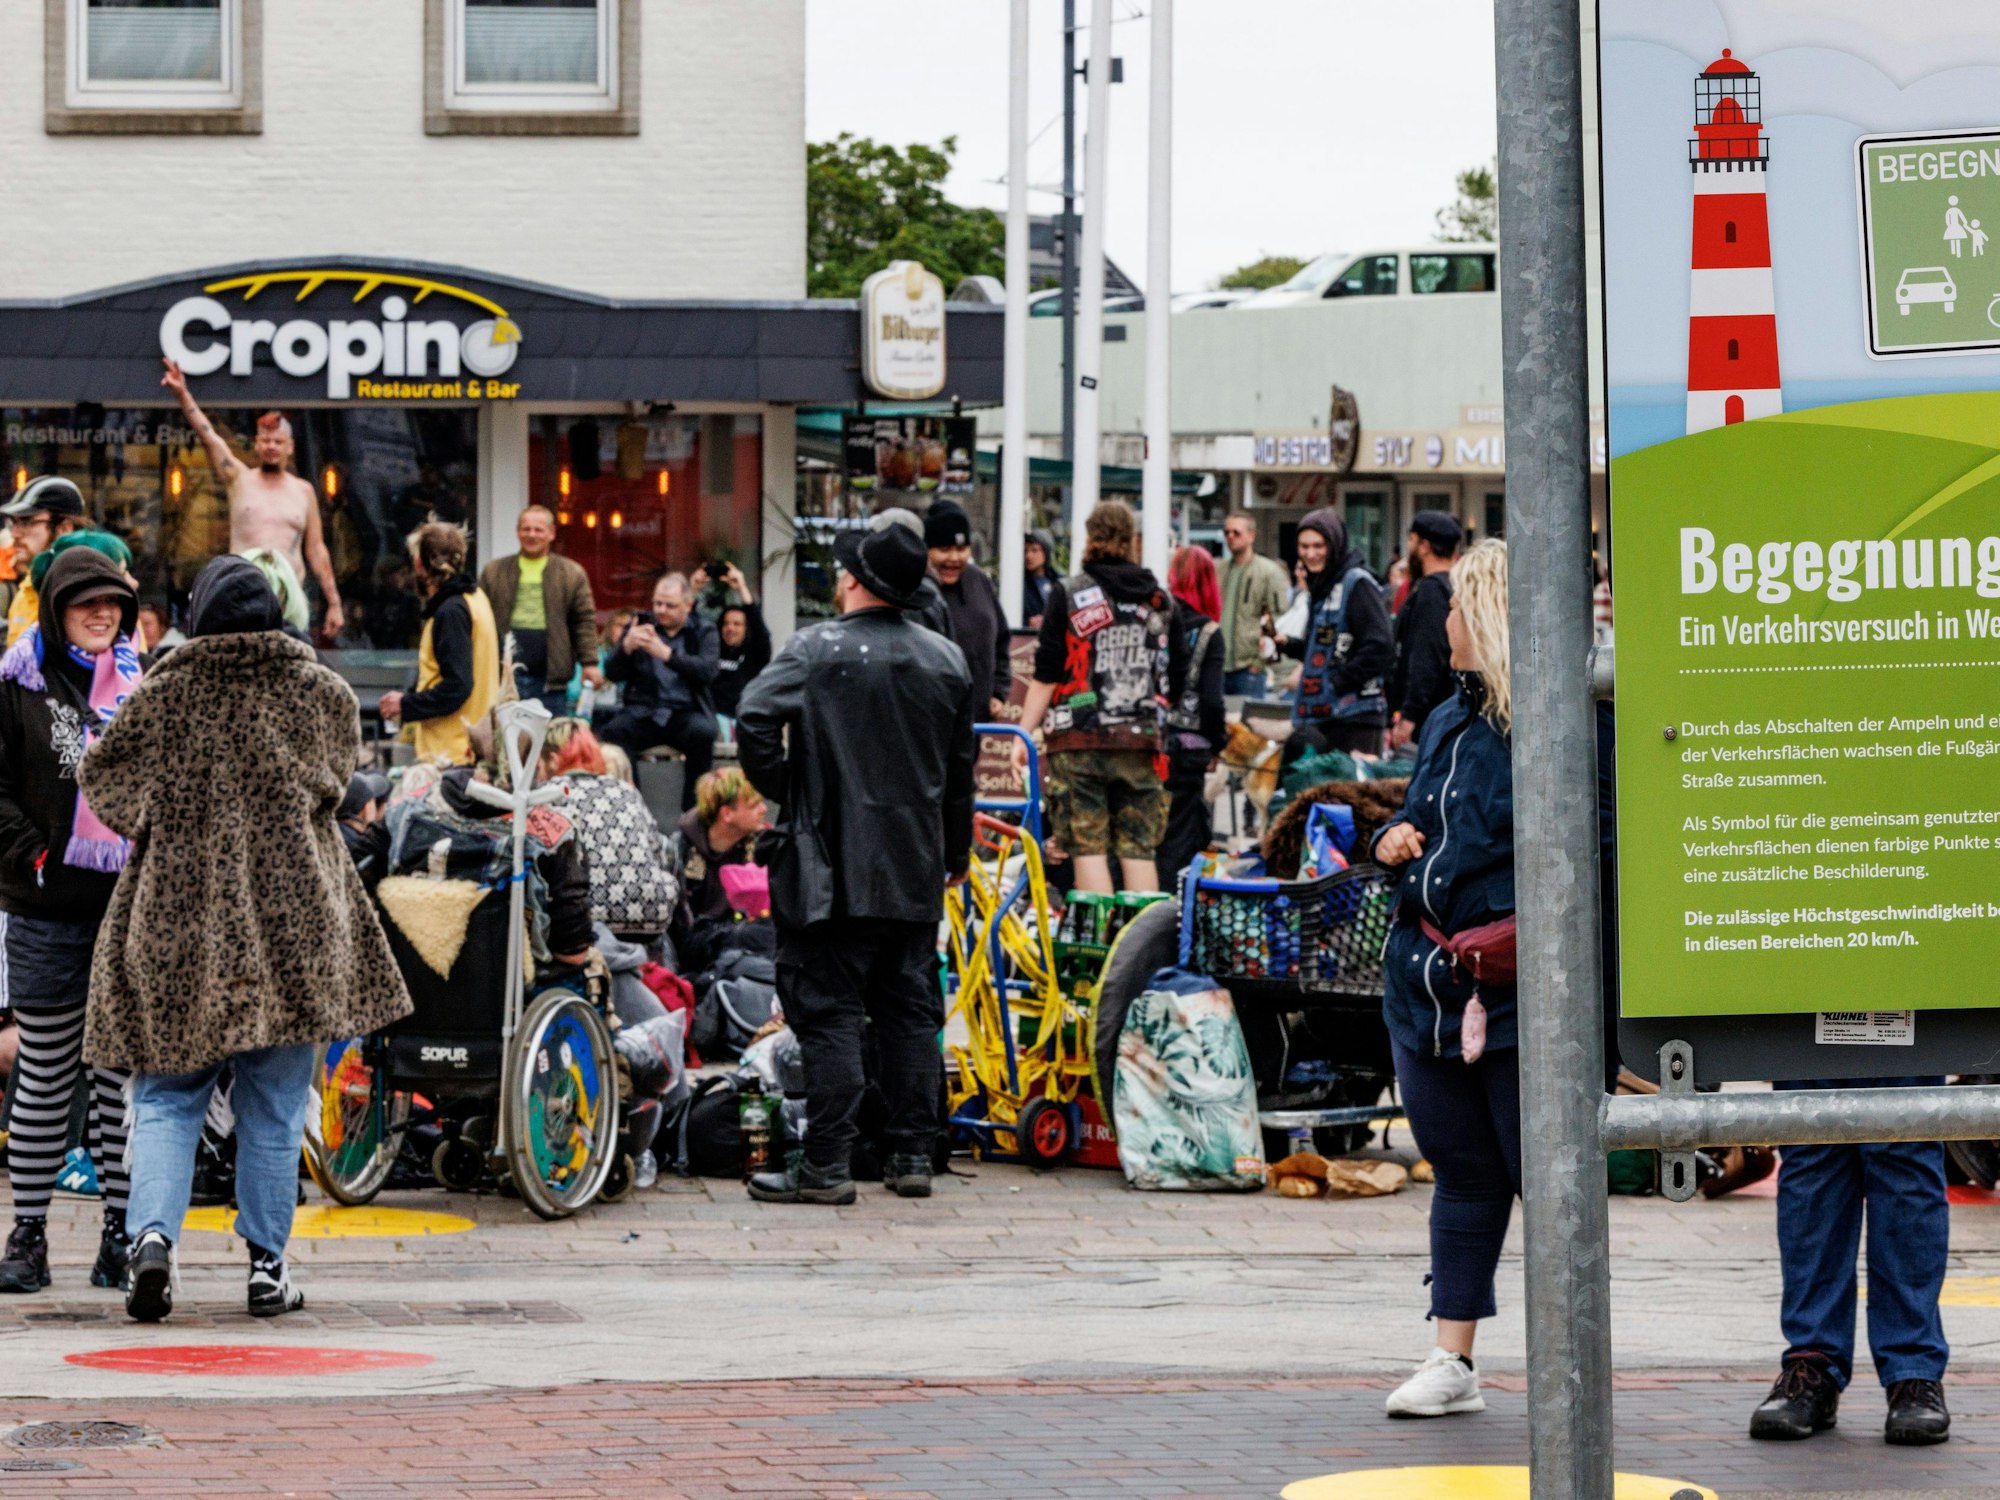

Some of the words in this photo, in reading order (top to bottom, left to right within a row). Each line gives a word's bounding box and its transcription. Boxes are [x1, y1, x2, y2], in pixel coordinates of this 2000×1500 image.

[1878, 148, 2000, 183] BEGEGN
[159, 296, 522, 399] Cropino
[358, 379, 461, 398] Restaurant
[467, 379, 481, 398] &
[486, 379, 521, 398] Bar
[6, 424, 127, 444] Restaurant
[1679, 526, 2000, 605] Begegnung
[1679, 616, 1716, 647] Ein
[1721, 610, 1930, 646] Verkehrsversuch
[1936, 610, 1959, 640] in
[1681, 720, 1730, 737] Durch
[1733, 719, 1762, 736] das
[1764, 717, 1854, 735] Abschalten
[1857, 716, 1885, 732] der
[1887, 714, 1950, 733] Ampeln
[1954, 713, 1985, 729] und
[1680, 747, 1708, 763] der
[1710, 743, 1840, 762] Verkehrsflächen
[1843, 742, 1913, 758] wachsen
[1916, 740, 1942, 757] die
[1681, 772, 1735, 789] Straße
[1737, 773, 1827, 788] zusammen.
[1681, 815, 1708, 832] Als
[1711, 814, 1771, 834] Symbol
[1773, 813, 1799, 829] für
[1800, 812, 1827, 829] die
[1829, 811, 1920, 831] gemeinsam
[1682, 839, 1812, 858] Verkehrsflächen
[1815, 838, 1870, 854] dienen
[1873, 836, 1930, 855] farbige
[1933, 834, 1991, 851] Punkte
[1683, 867, 1718, 884] eine
[1721, 865, 1809, 883] zusätzliche
[1813, 862, 1929, 881] Beschilderung.
[1684, 910, 1714, 927] Die
[1715, 908, 1791, 927] zulässige
[1793, 902, 1985, 925] Höchstgeschwindigkeit
[1684, 936, 1701, 953] in
[1703, 935, 1758, 952] diesen
[1760, 932, 1845, 950] Bereichen
[1846, 931, 1869, 948] 20
[1870, 930, 1920, 947] km/h.
[420, 1046, 469, 1062] SOPUR
